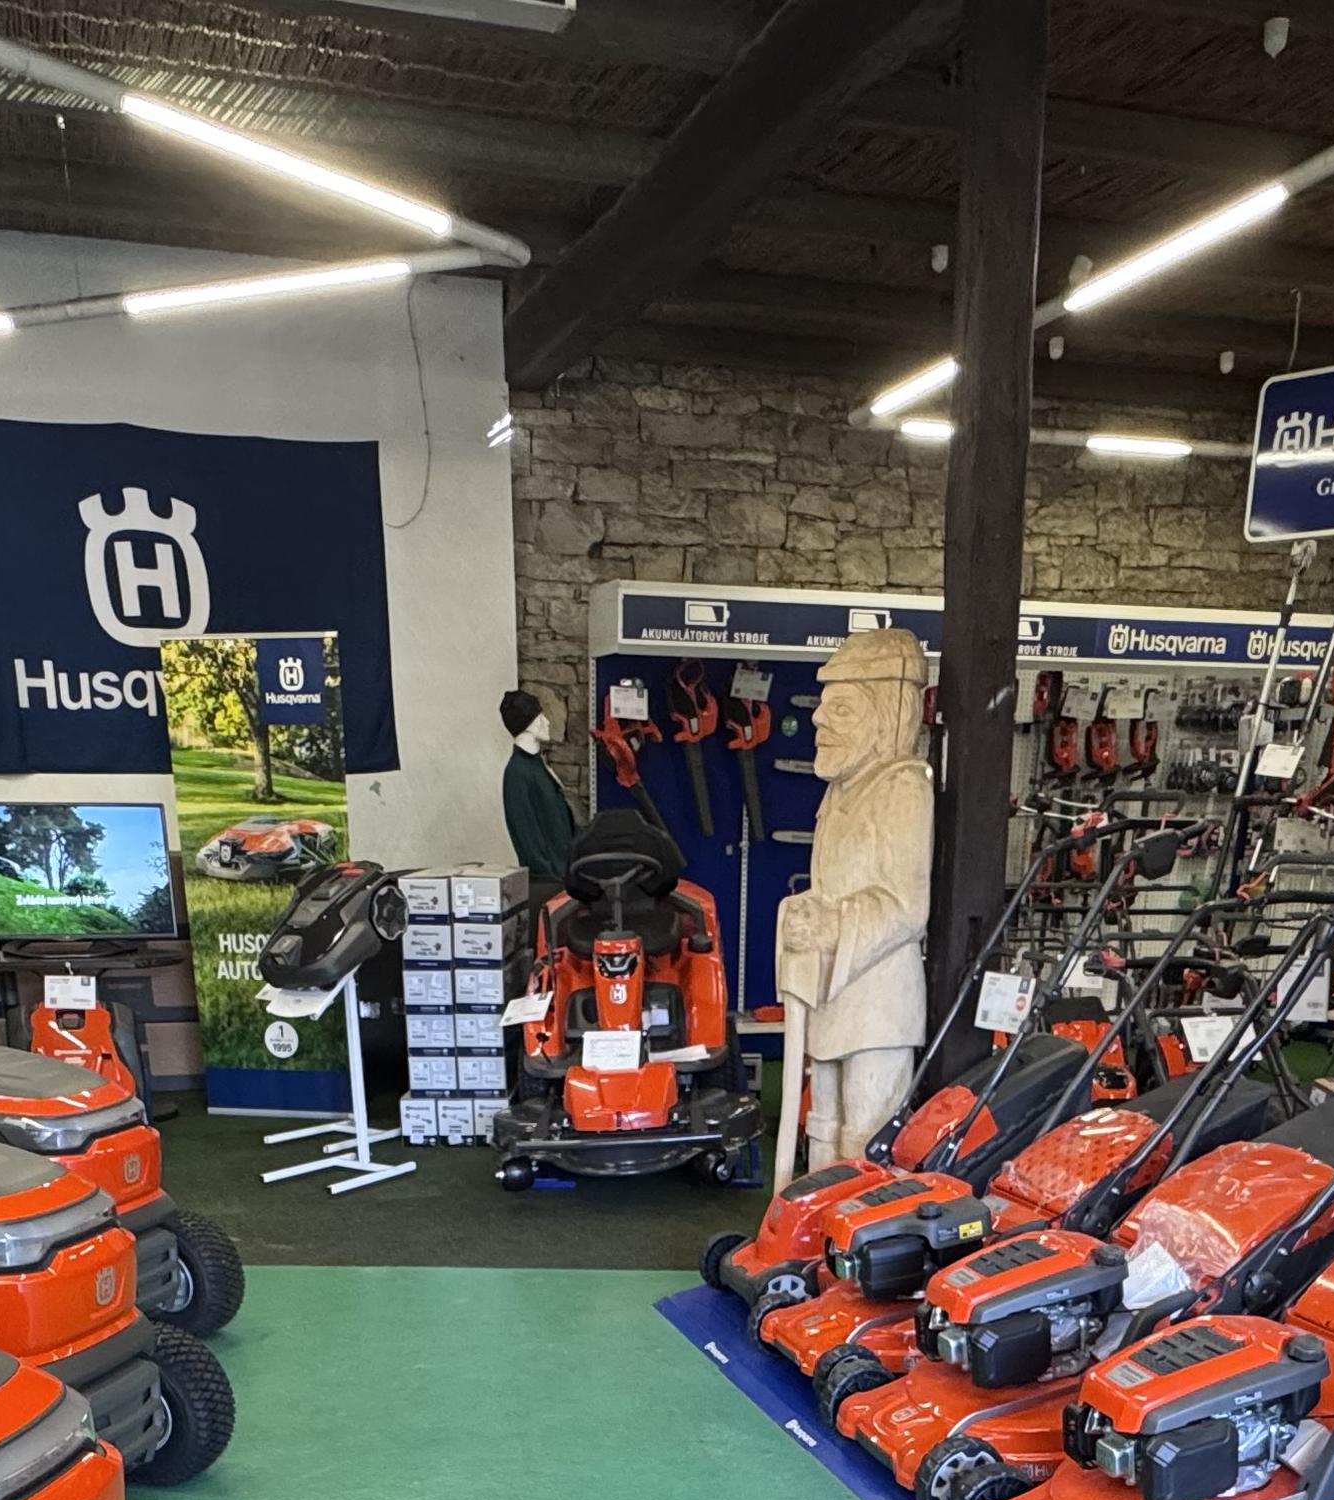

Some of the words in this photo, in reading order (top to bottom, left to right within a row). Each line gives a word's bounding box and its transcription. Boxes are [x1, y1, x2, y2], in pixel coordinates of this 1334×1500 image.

[641, 627, 728, 643] AKUMULÁTOROVÉ
[734, 632, 770, 645] STROJE
[807, 635, 846, 648] AKUMU
[1129, 630, 1227, 655] Husqvarna
[1018, 643, 1041, 656] ROVÉ
[1046, 644, 1078, 657] STROJE
[14, 658, 166, 717] Husq
[265, 691, 322, 706] Husqvarna
[218, 933, 268, 953] HUSQ
[217, 961, 264, 980] AUTO
[272, 1043, 293, 1053] 1995
